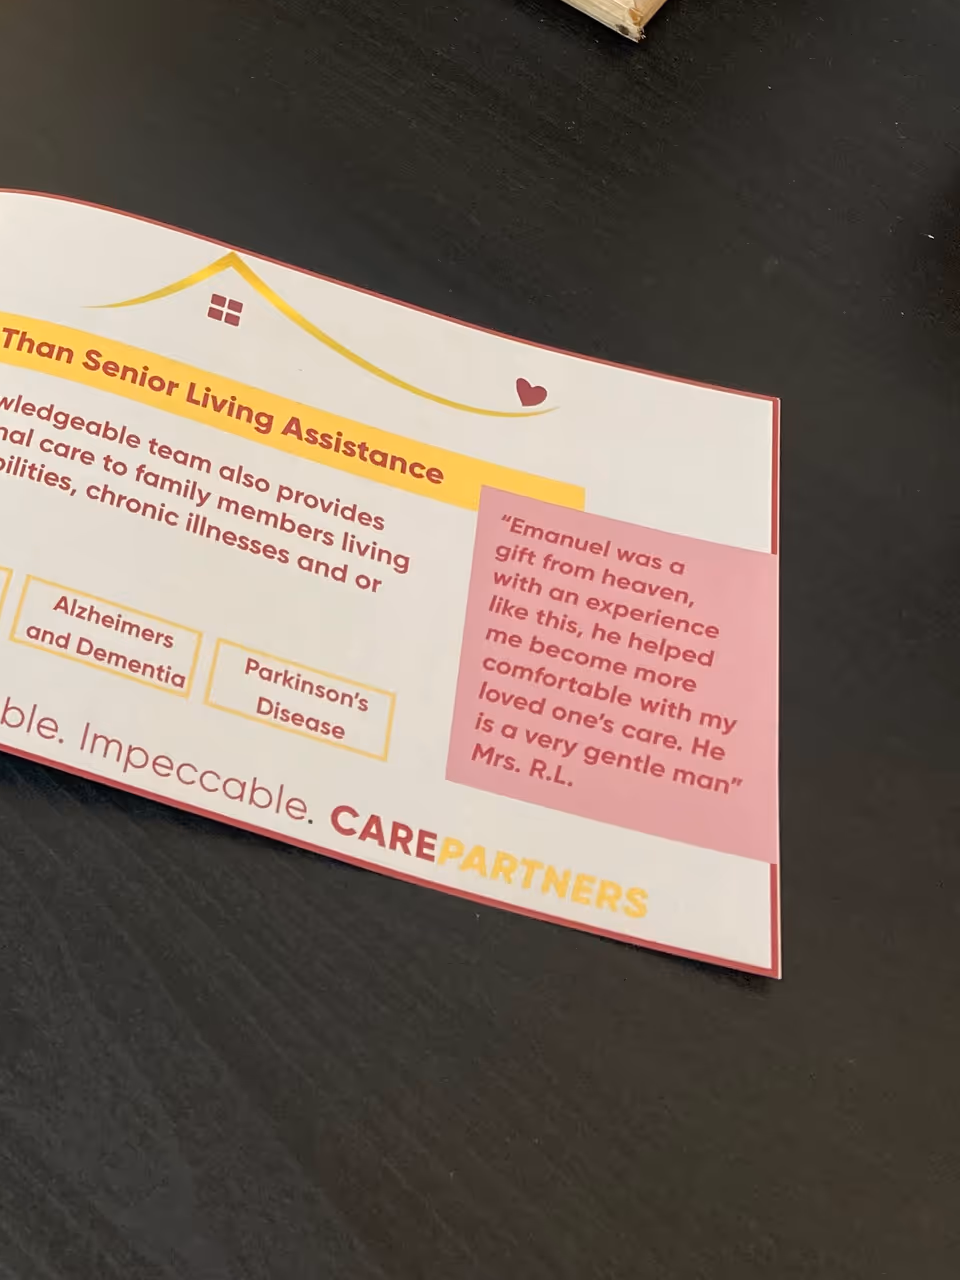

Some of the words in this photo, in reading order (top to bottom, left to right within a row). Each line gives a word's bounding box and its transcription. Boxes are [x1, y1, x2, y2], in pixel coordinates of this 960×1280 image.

[2, 327, 74, 364] Than
[82, 349, 180, 397] Senior
[186, 382, 274, 434] Living
[281, 416, 444, 484] Assistance
[39, 438, 95, 465] care
[103, 455, 128, 476] to
[135, 464, 211, 507] family
[217, 496, 334, 546] members
[341, 532, 410, 574] living
[149, 438, 212, 473] team
[219, 465, 270, 492] also
[276, 484, 385, 530] provides
[86, 484, 179, 527] chronic
[186, 512, 290, 564] illnesses
[298, 556, 348, 583] and
[355, 573, 382, 593] or
[616, 549, 662, 569] was
[669, 561, 686, 574] a
[493, 573, 542, 595] with
[549, 588, 579, 605] an
[586, 596, 720, 639] experience
[495, 545, 536, 565] gift
[543, 554, 595, 581] from
[601, 569, 695, 608] heaven,
[53, 595, 174, 648] Alzheimers
[489, 595, 528, 620] like
[536, 609, 583, 638] this,
[591, 623, 621, 644] he
[628, 633, 715, 667] helped
[26, 626, 71, 649] and
[76, 637, 186, 689] Dementia
[486, 627, 522, 647] me
[529, 636, 627, 675] become
[634, 667, 697, 692] more
[256, 697, 345, 739] Disease
[478, 682, 546, 716] loved
[621, 722, 682, 750] care.
[691, 737, 726, 761] He
[483, 657, 632, 706] comfortable
[640, 696, 691, 722] with
[699, 711, 738, 735] my
[471, 744, 521, 772] Mrs.
[529, 759, 573, 787] R.L.
[475, 713, 493, 732] is
[501, 723, 518, 739] a
[525, 729, 578, 757] very
[583, 746, 666, 777] gentle
[80, 722, 313, 824] Impeccable.
[331, 805, 648, 918] CAREPARTNERS
